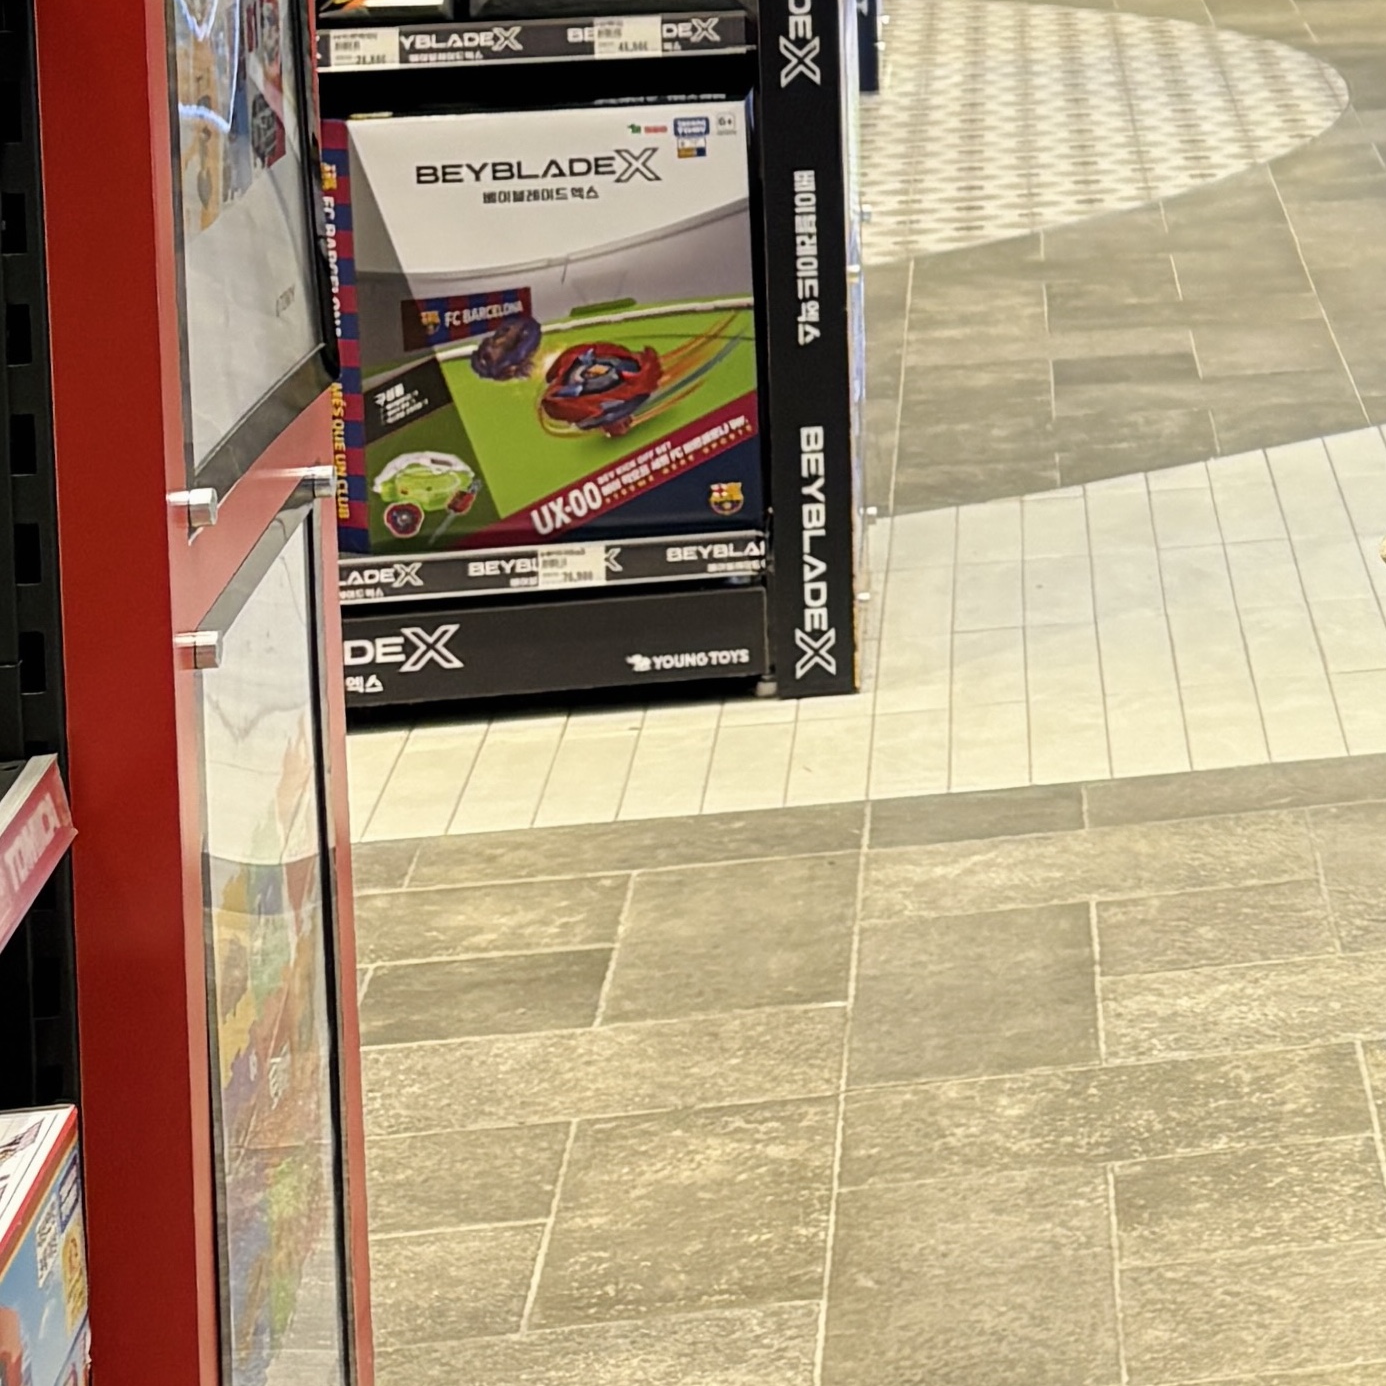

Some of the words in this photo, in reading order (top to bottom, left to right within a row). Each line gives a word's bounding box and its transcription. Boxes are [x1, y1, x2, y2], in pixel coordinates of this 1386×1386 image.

[444, 308, 462, 328] FC
[652, 652, 708, 671] YOUNG
[708, 648, 750, 666] TOYS
